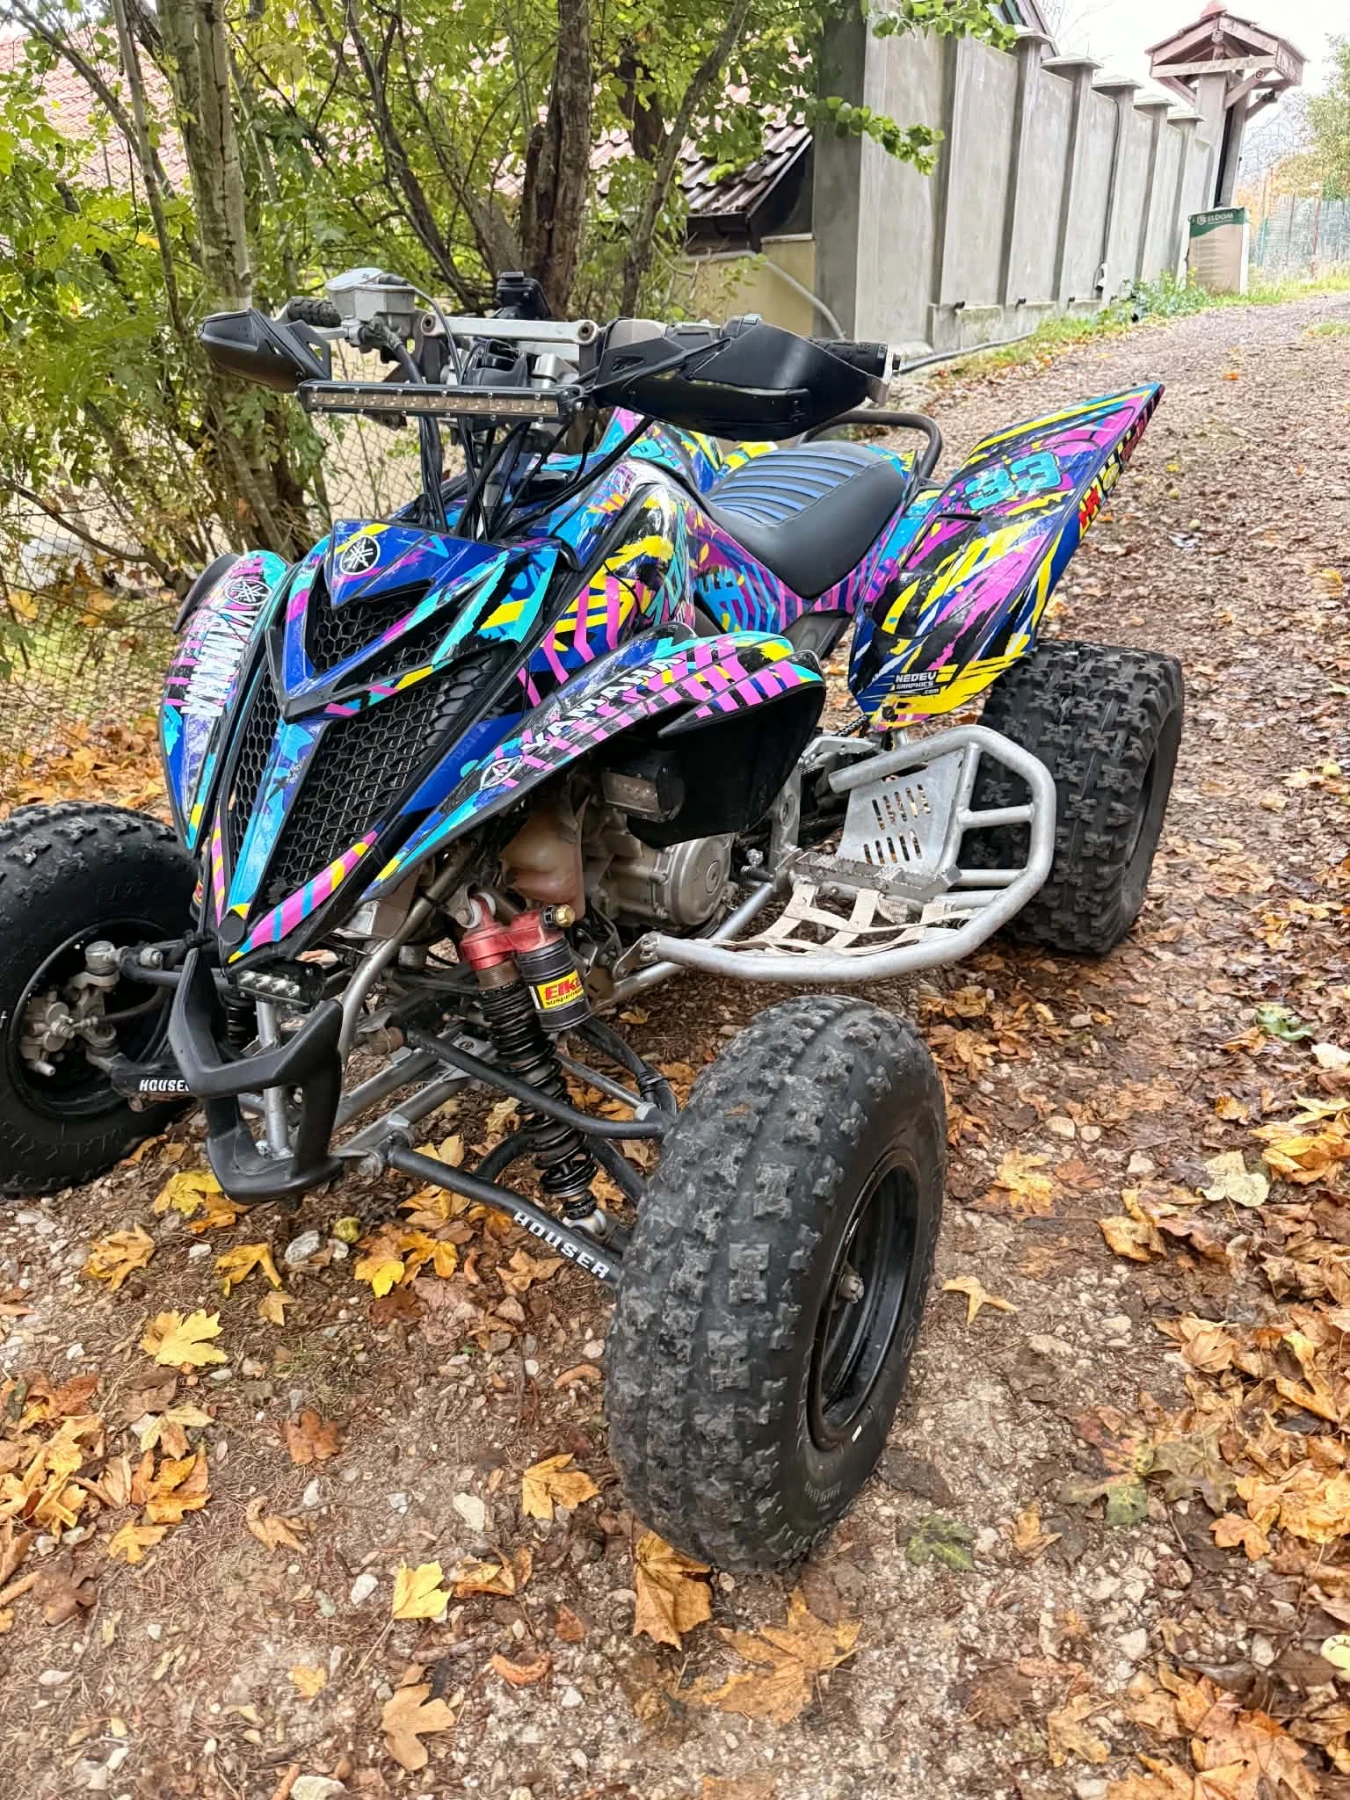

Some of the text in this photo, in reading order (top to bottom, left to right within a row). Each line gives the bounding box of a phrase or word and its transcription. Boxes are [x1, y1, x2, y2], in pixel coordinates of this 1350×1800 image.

[964, 450, 1062, 511] 33
[520, 657, 686, 752] YAMAHA
[513, 1211, 610, 1279] HOUSER
